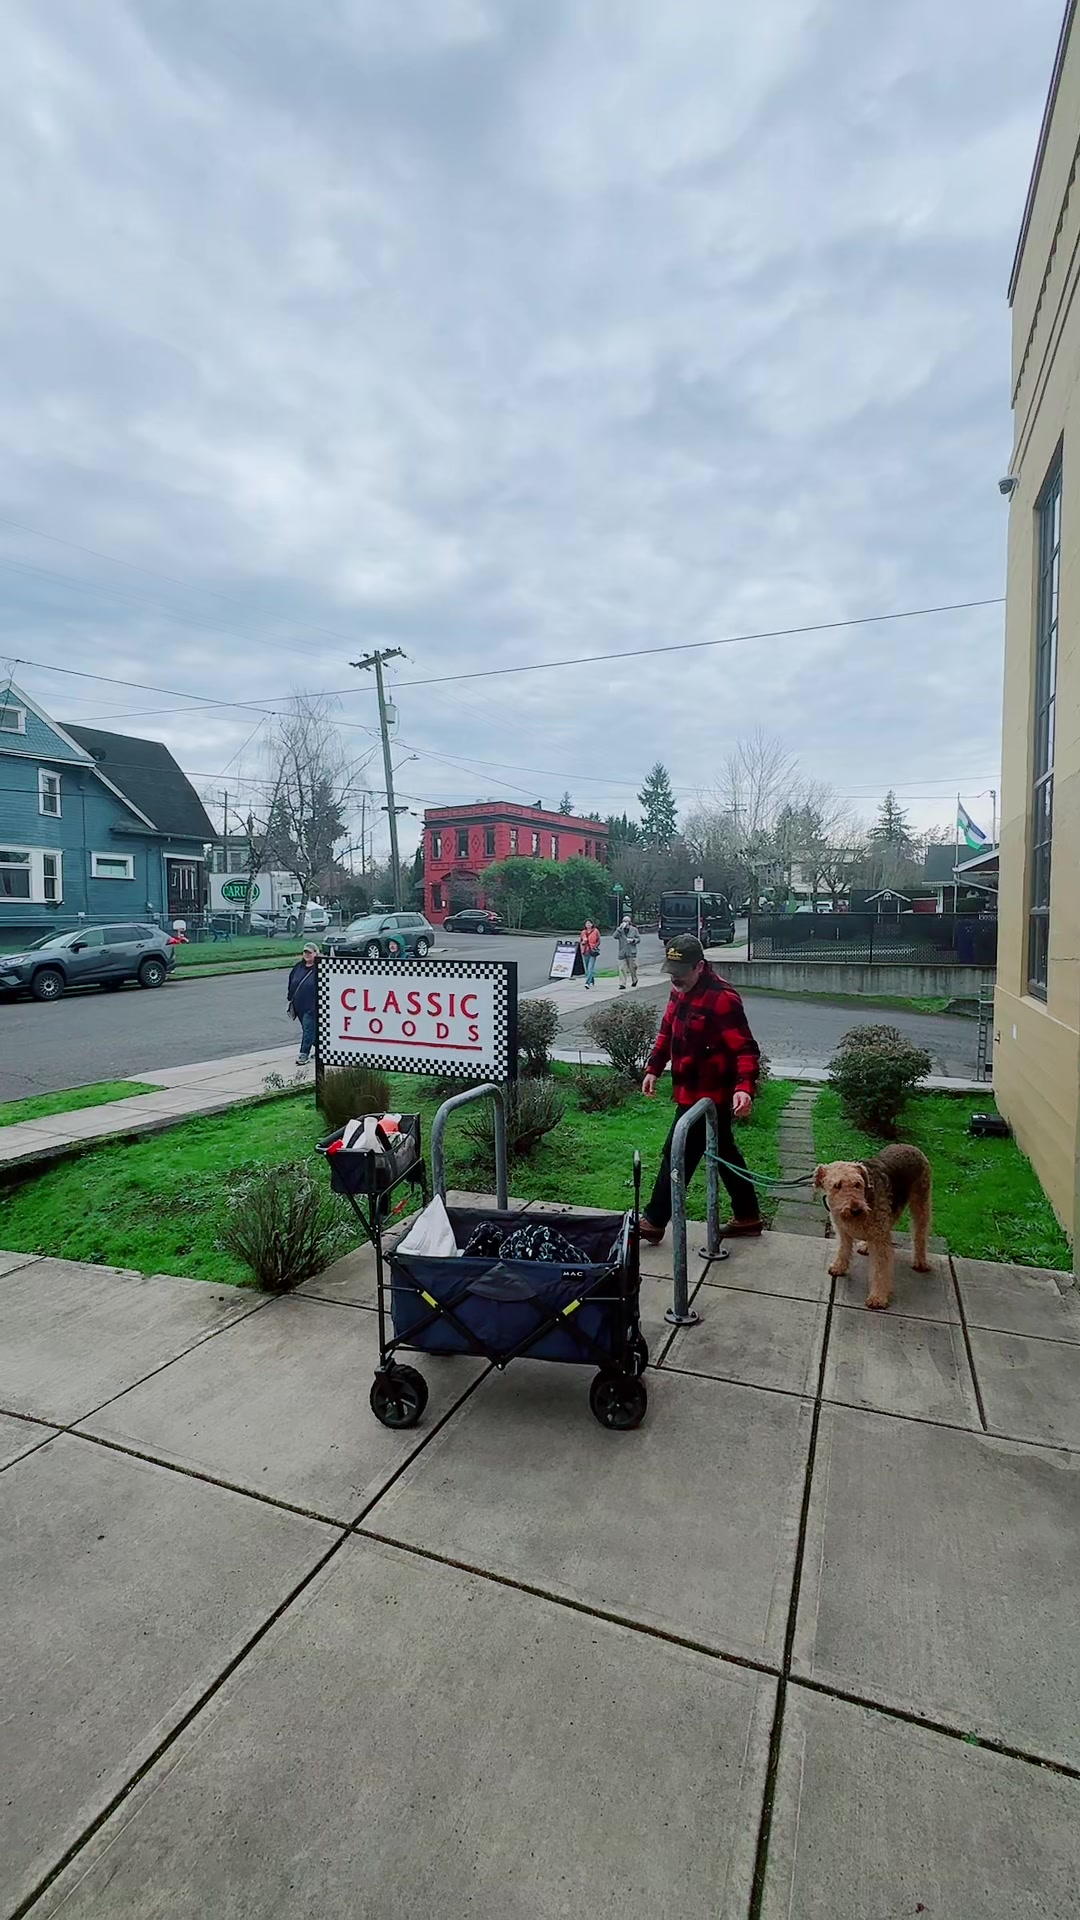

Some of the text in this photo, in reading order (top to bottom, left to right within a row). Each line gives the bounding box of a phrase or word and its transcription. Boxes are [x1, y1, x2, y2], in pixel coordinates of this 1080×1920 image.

[223, 885, 259, 897] CARUO
[340, 988, 479, 1019] CLASSIC
[343, 1016, 479, 1042] FOODS
